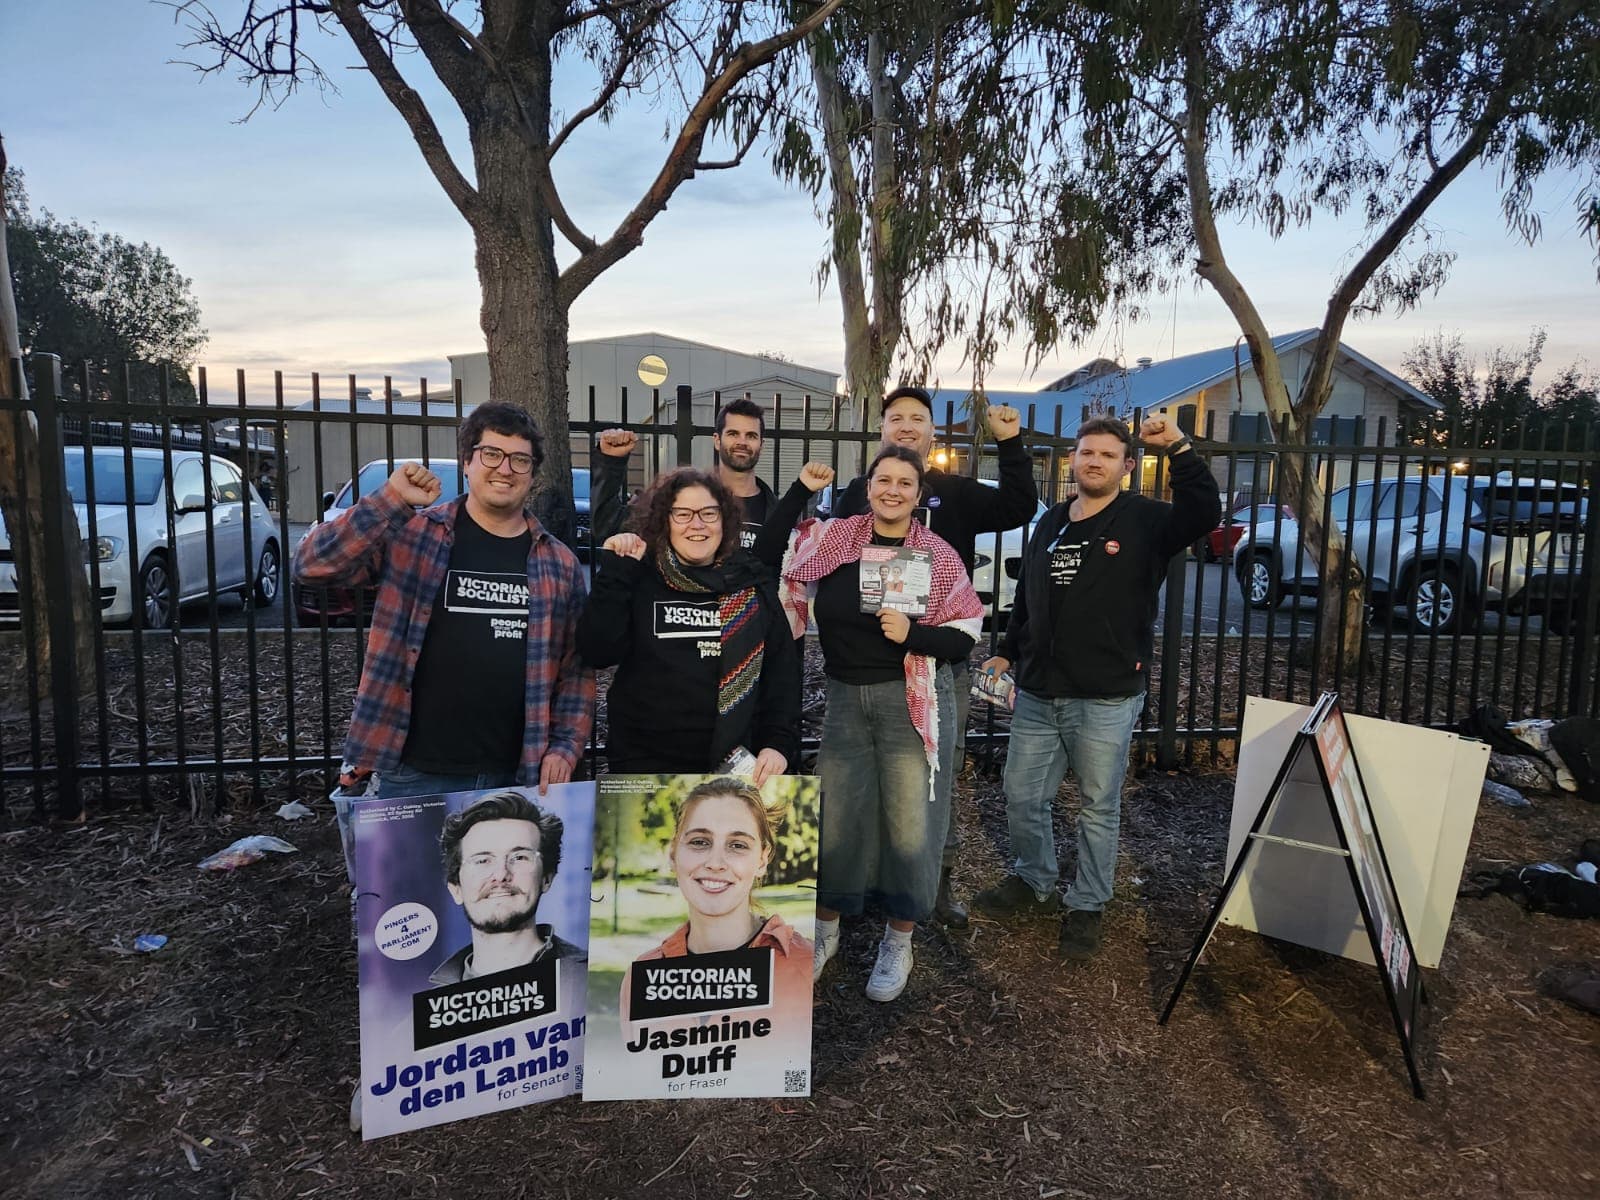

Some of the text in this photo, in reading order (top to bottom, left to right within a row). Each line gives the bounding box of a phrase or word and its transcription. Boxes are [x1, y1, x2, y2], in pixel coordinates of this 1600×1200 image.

[457, 586, 530, 605] SOCIALIST
[664, 606, 721, 619] VICTORIA
[664, 615, 721, 627] SOCIALIS
[490, 618, 528, 629] people
[494, 630, 522, 639] profit
[384, 912, 419, 930] PINGERS
[401, 924, 409, 933] 4
[381, 924, 432, 949] PARLIAMENT
[645, 968, 752, 984] VICTORIAN
[428, 980, 538, 1012] VICTORIAN
[645, 984, 759, 1001] SOCIALISTS
[429, 995, 545, 1029] SOCIALISTS
[627, 1014, 772, 1053] Jasmine
[370, 1015, 586, 1097] Jordan van
[661, 1045, 737, 1079] Duff
[399, 1045, 569, 1116] den Lamb
[497, 1071, 570, 1102] for Senate
[668, 1077, 729, 1092] for Fraser
